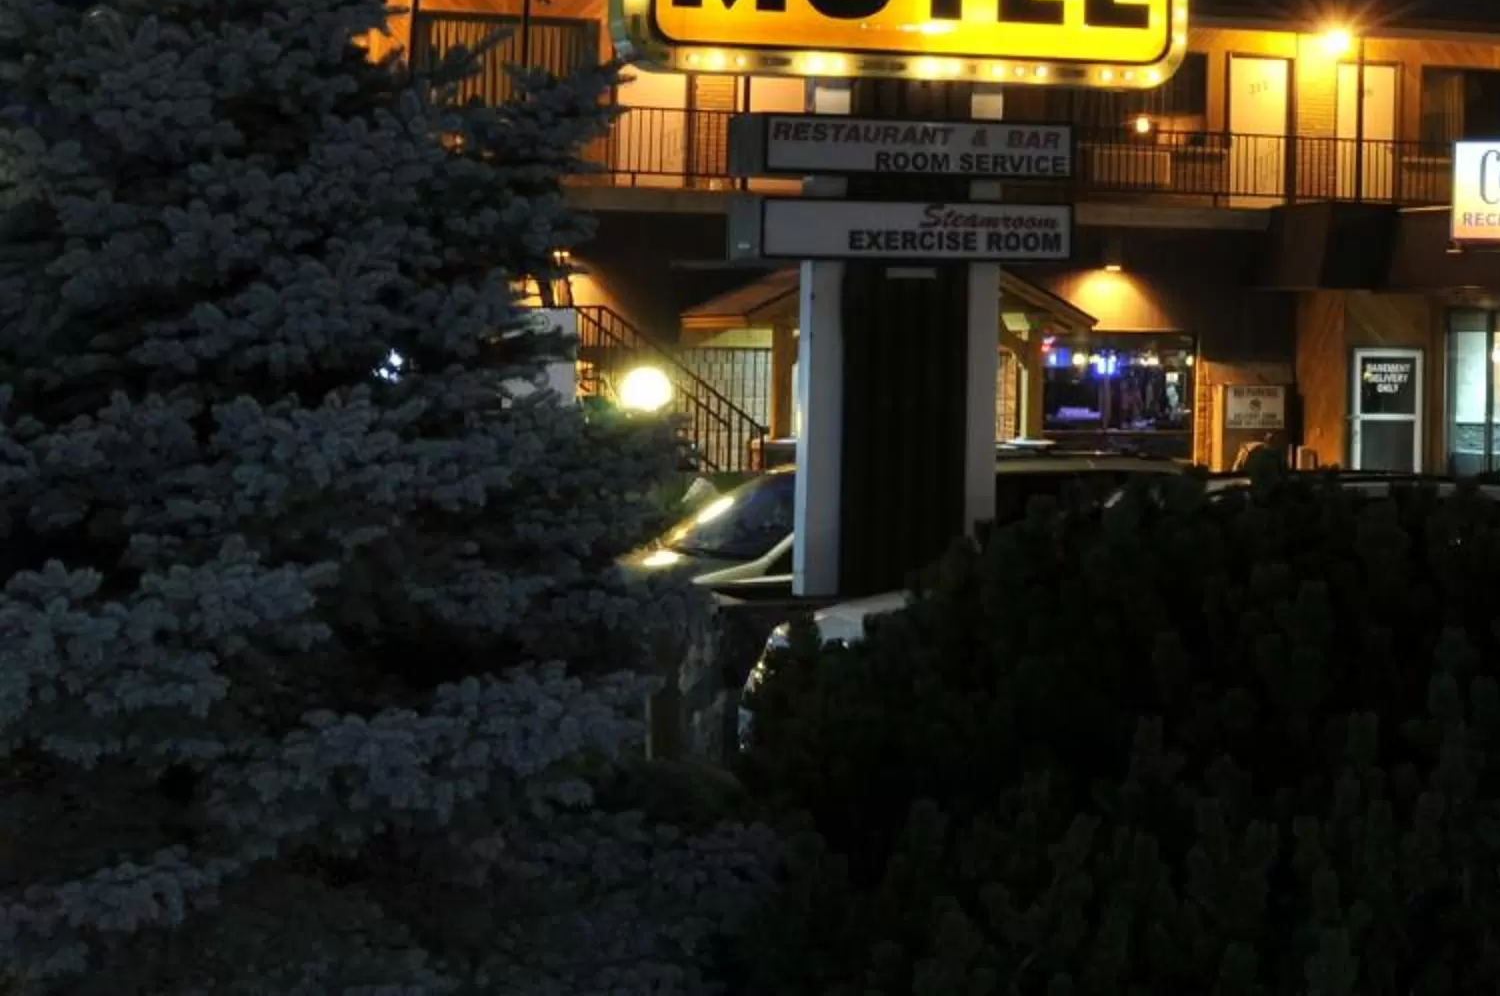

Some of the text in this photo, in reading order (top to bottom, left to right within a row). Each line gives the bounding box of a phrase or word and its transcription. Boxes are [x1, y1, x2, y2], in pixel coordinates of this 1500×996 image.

[772, 121, 1061, 149] RESTAURANT & BAR
[875, 151, 1067, 173] ROOM SERVICE
[919, 203, 1060, 230] Steamroom
[847, 230, 1062, 253] EXERCISE ROOM
[1367, 373, 1409, 384] DELIVERY
